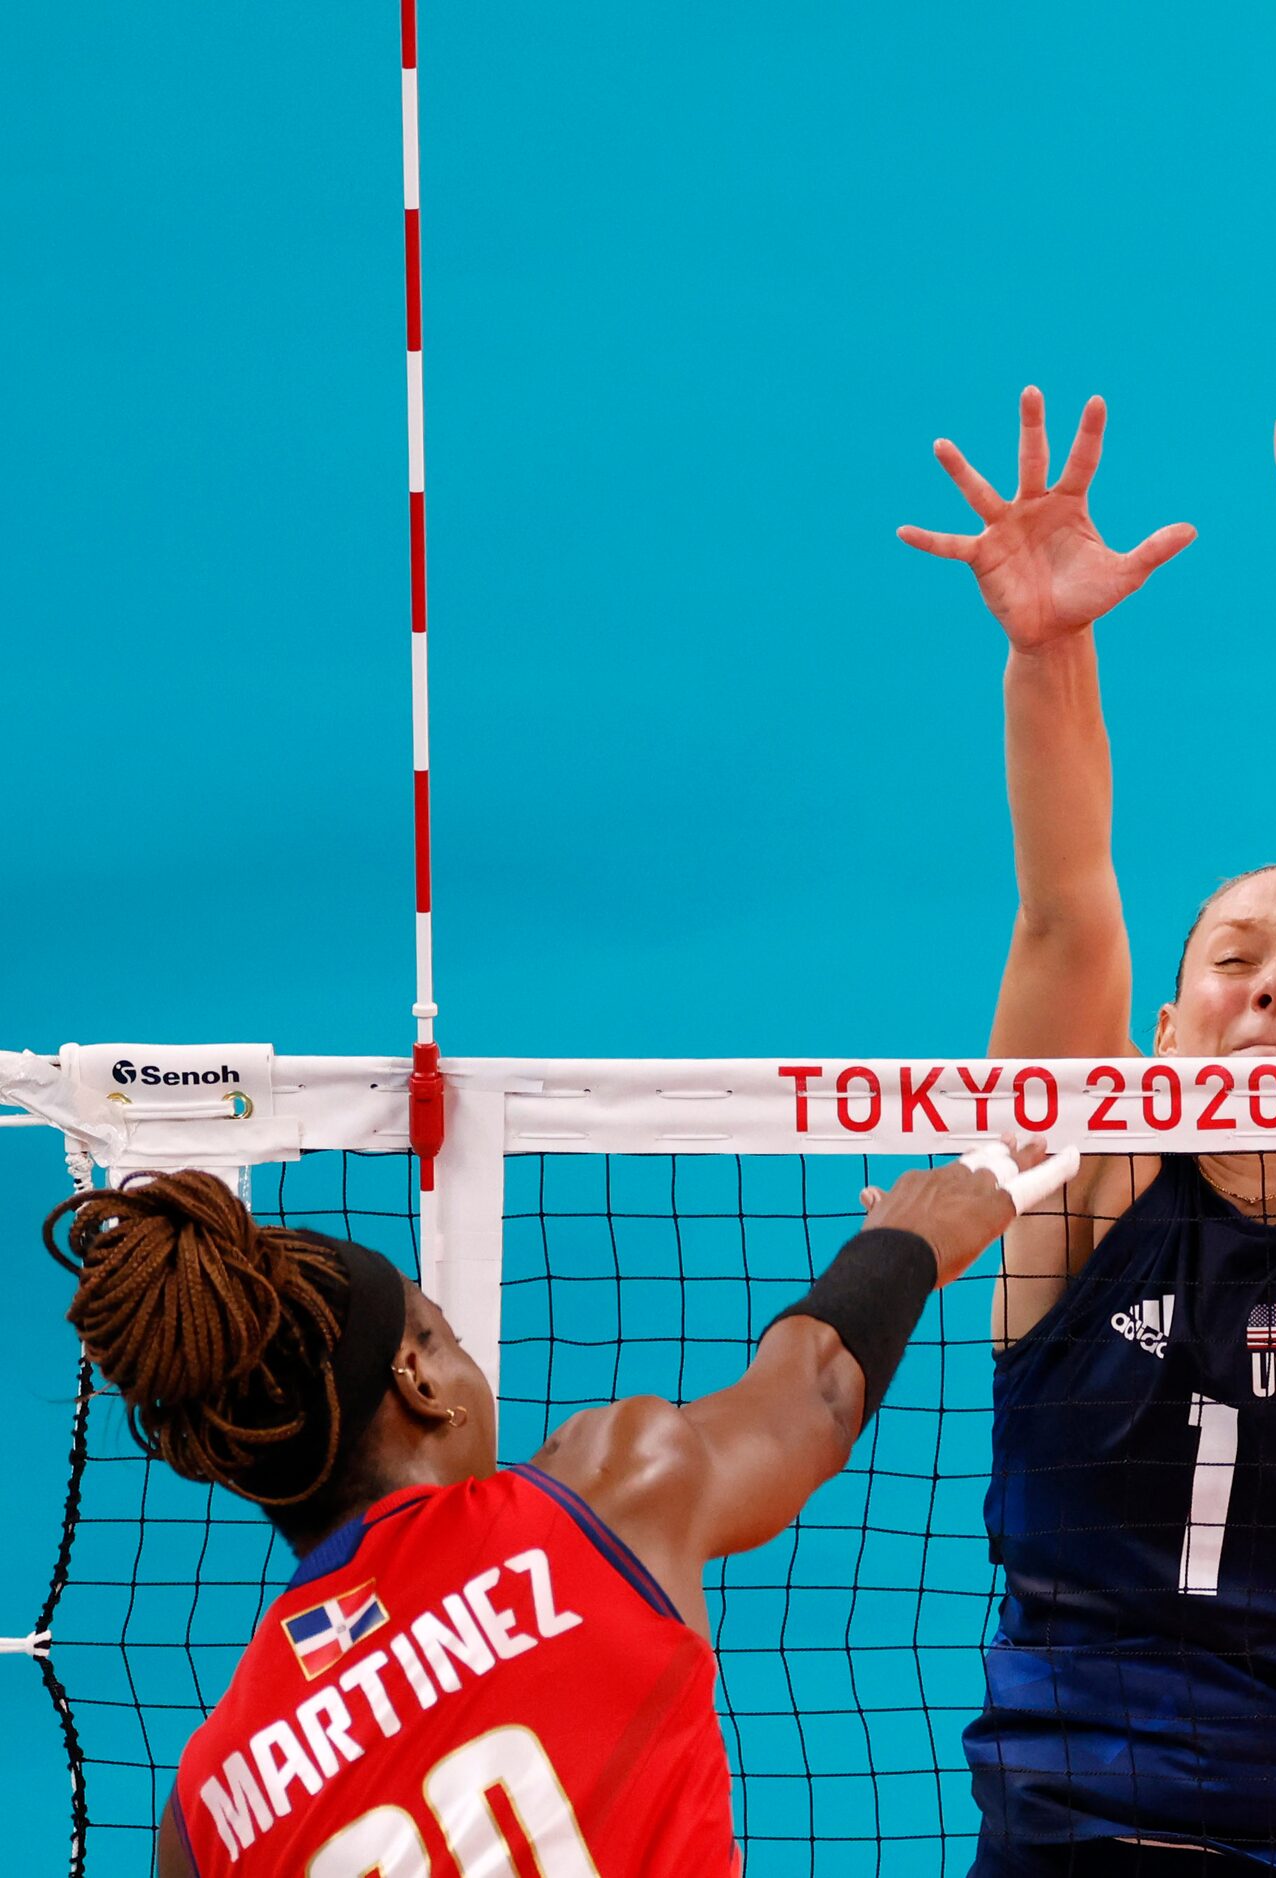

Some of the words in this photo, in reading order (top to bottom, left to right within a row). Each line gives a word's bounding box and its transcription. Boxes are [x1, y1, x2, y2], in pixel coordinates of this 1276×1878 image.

[141, 1065, 240, 1085] Senoh
[778, 1066, 1058, 1133] TOKYO
[1178, 1392, 1240, 1597] 1
[200, 1548, 584, 1863] MARTINEZ
